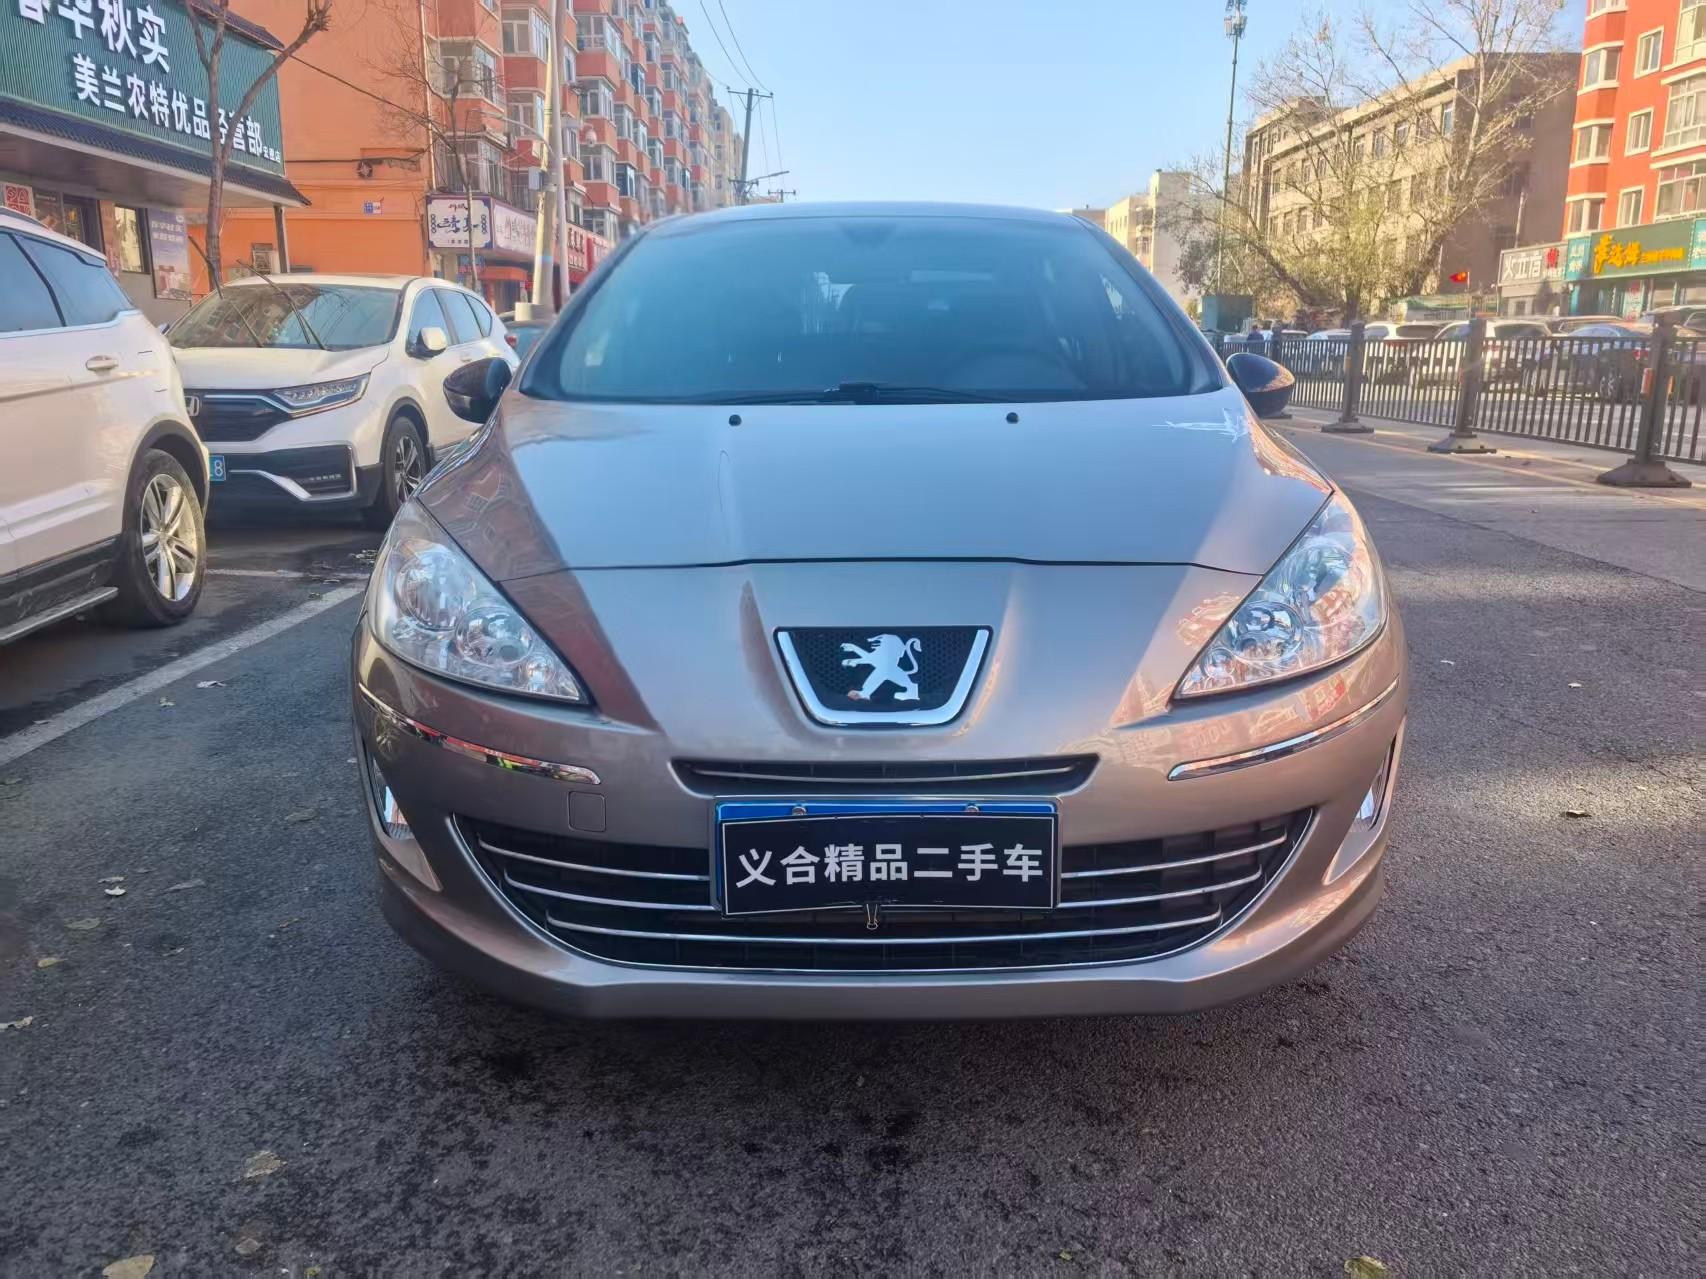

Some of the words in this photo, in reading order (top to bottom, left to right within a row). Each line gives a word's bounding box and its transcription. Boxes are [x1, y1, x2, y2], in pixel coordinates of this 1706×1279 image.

[736, 843, 1043, 888] 义合精品二手车
